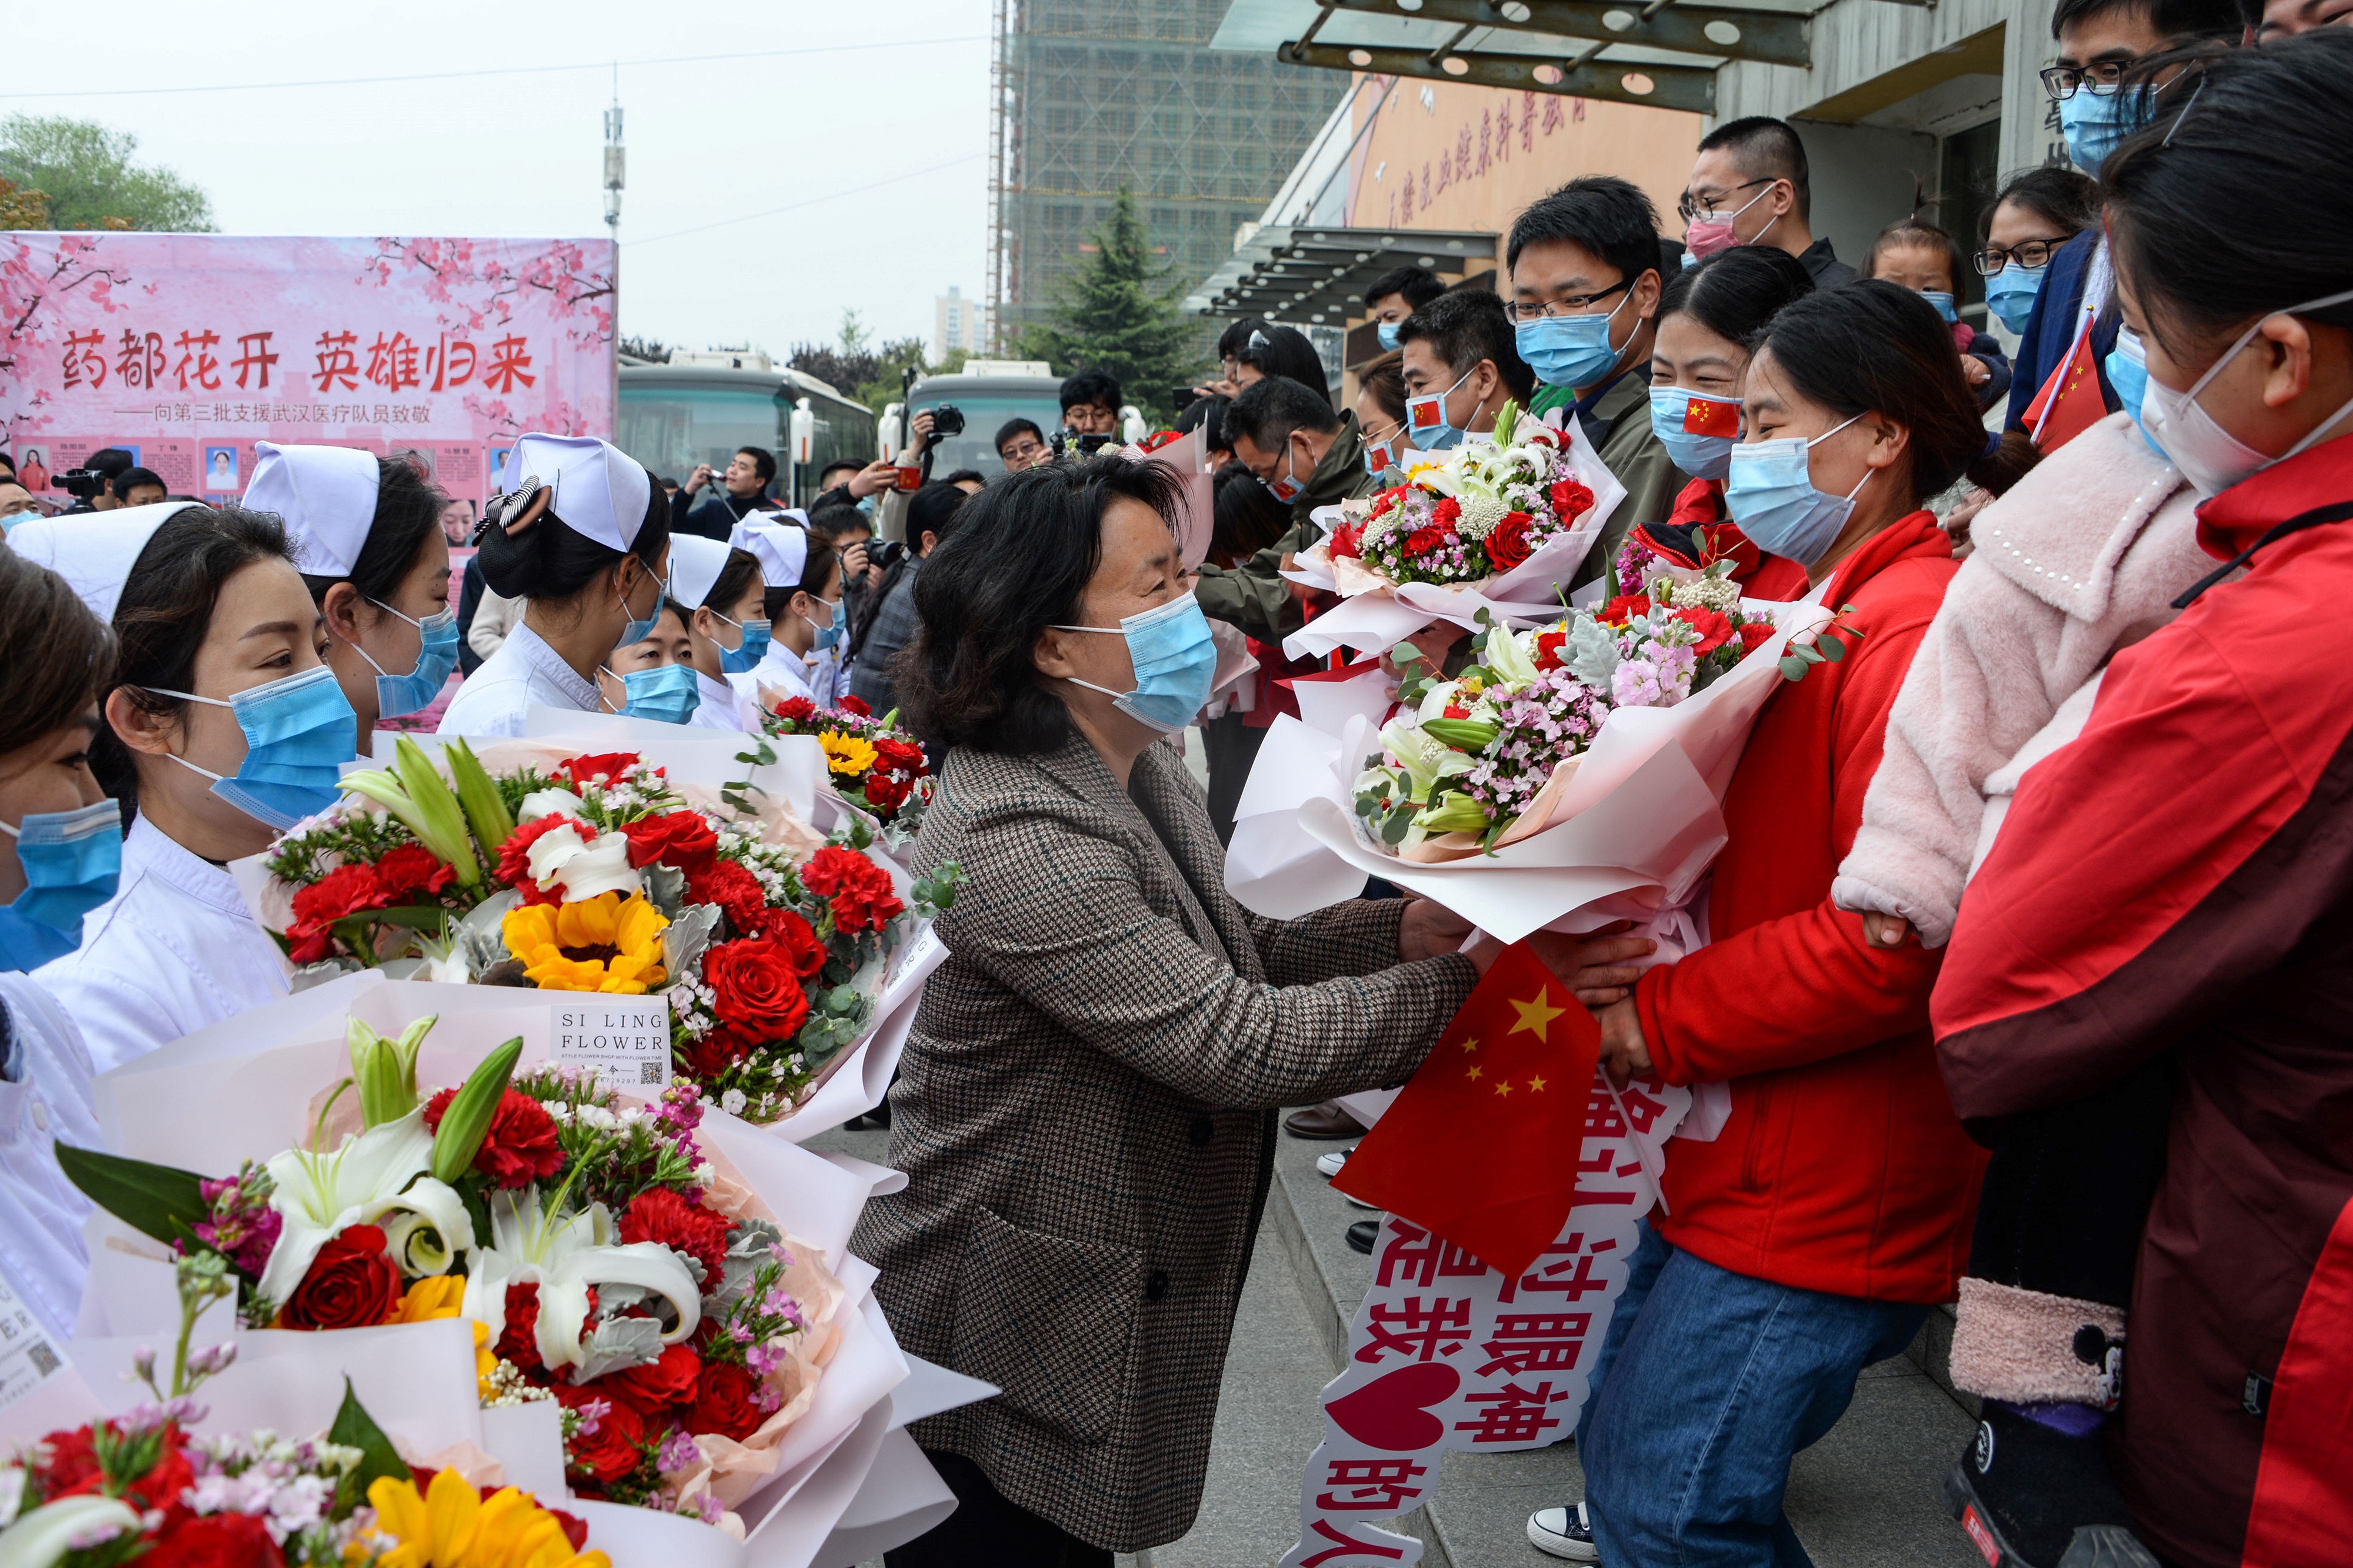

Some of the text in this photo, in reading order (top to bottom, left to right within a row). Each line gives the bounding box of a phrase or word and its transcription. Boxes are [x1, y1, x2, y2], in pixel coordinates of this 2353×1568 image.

[62, 328, 536, 395] 药都花开 英雄归来
[562, 1013, 662, 1028] SI LING
[561, 1035, 663, 1050] FLOWER
